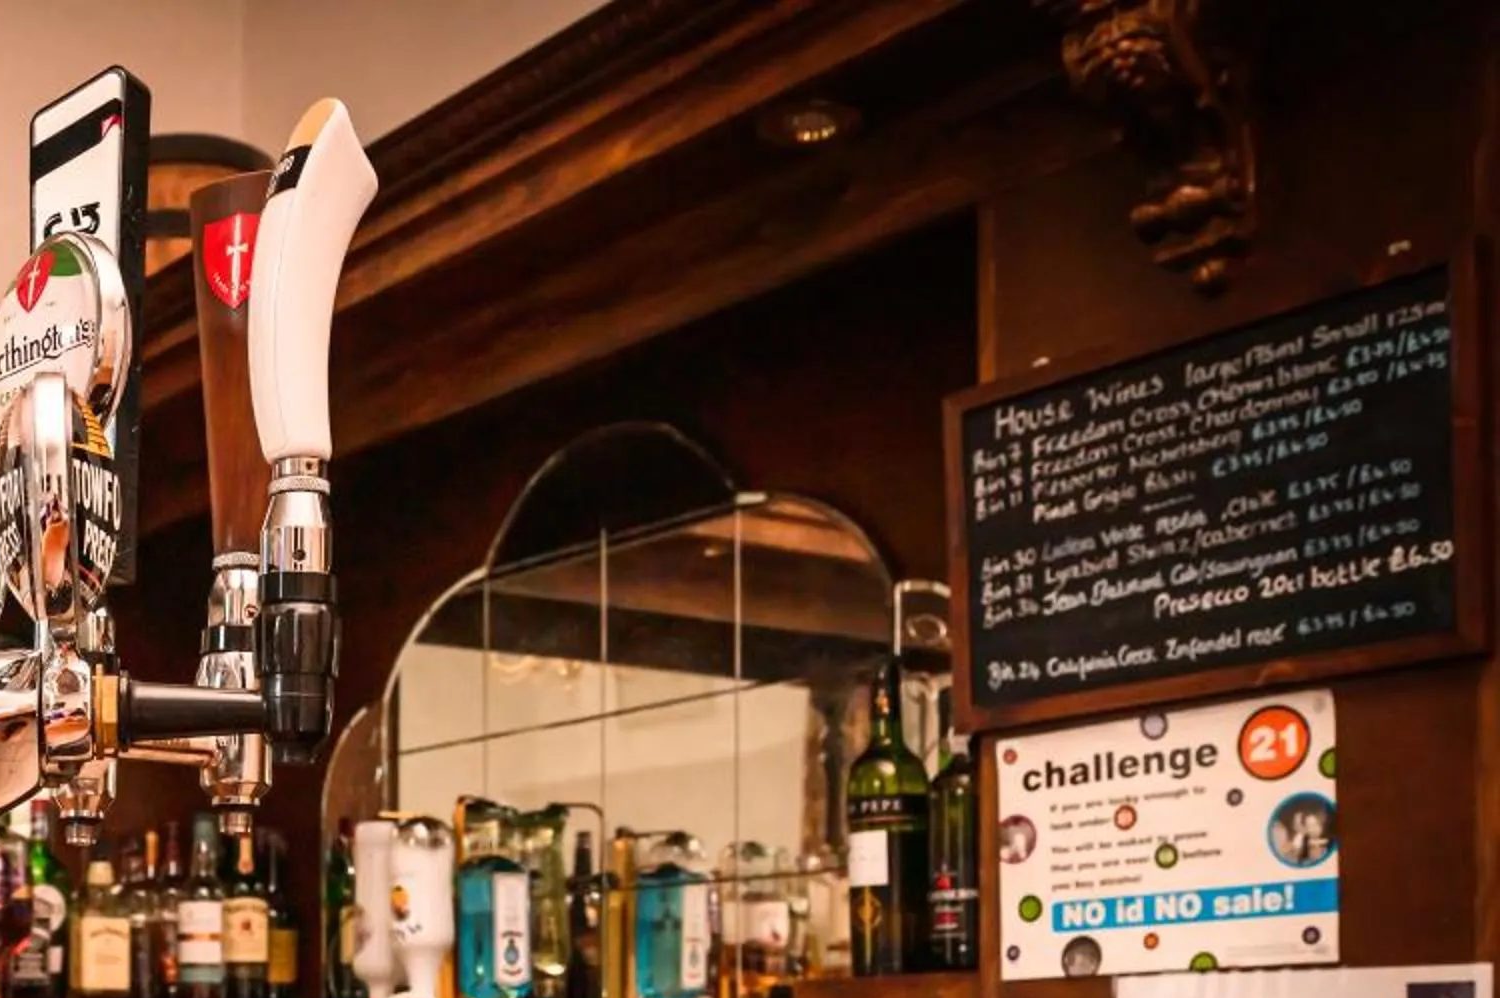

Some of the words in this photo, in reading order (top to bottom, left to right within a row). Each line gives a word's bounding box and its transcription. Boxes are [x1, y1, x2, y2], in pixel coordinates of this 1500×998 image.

[995, 400, 1074, 439] House
[1086, 374, 1164, 411] Wines
[1031, 419, 1125, 459] Freedom
[1031, 443, 1118, 482] Freedom
[1153, 585, 1250, 620] Prosecco
[1310, 556, 1382, 588] bottle
[1022, 742, 1219, 793] challenge
[1249, 723, 1299, 763] 21
[1061, 903, 1106, 928] NO
[1115, 900, 1145, 925] id
[1154, 893, 1204, 921] NO
[1212, 885, 1296, 923] sale!
